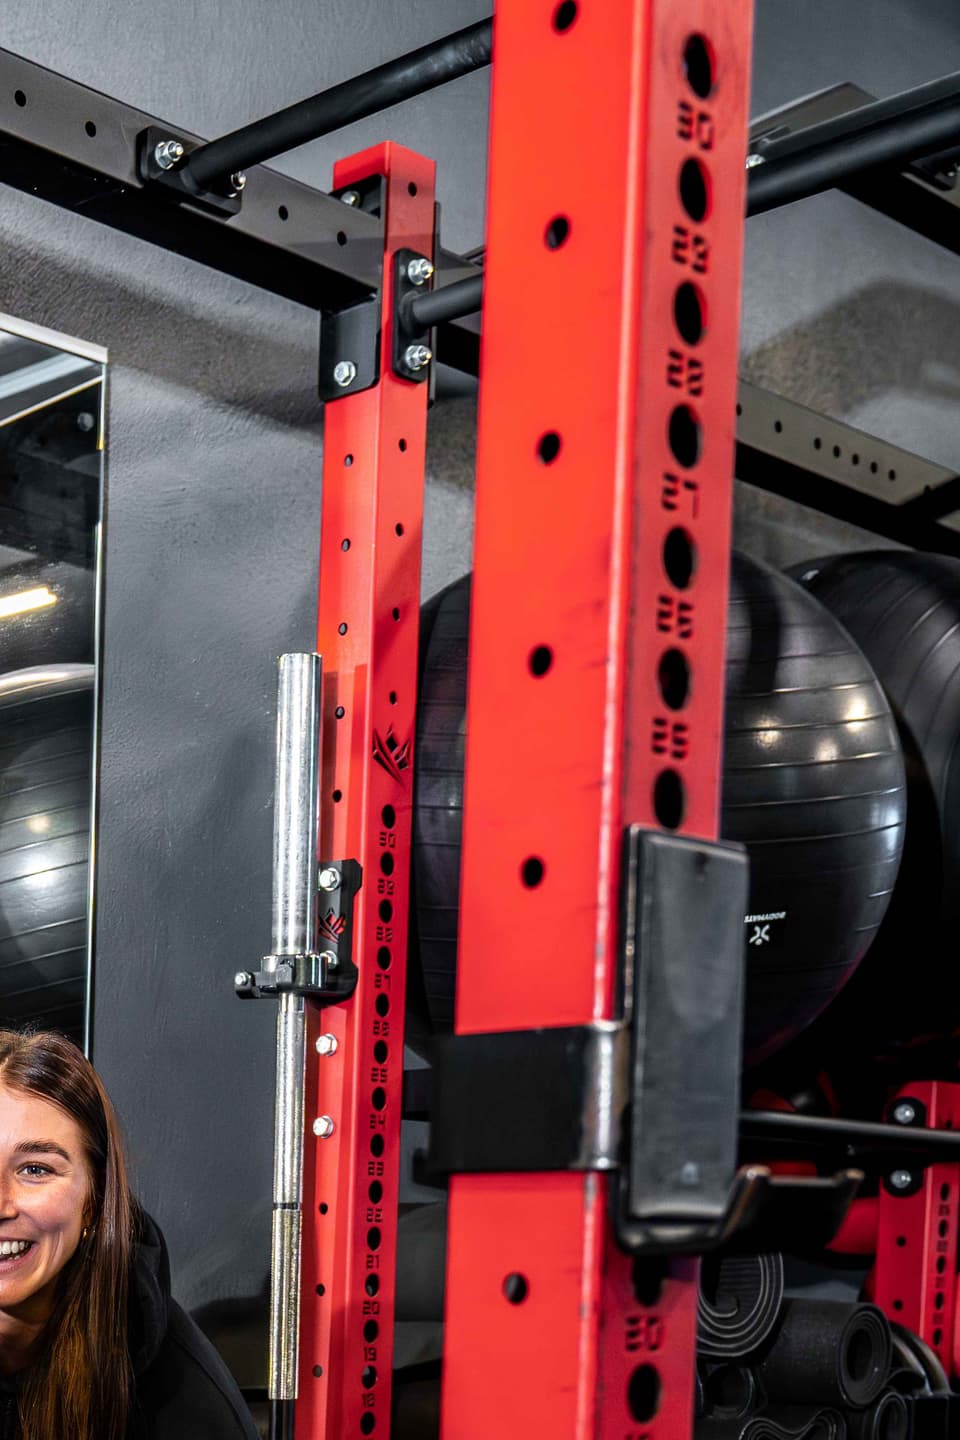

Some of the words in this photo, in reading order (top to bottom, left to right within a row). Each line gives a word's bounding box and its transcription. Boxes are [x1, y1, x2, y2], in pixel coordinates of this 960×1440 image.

[677, 101, 712, 151] 30
[661, 472, 700, 519] 27
[624, 1315, 661, 1352] 20
